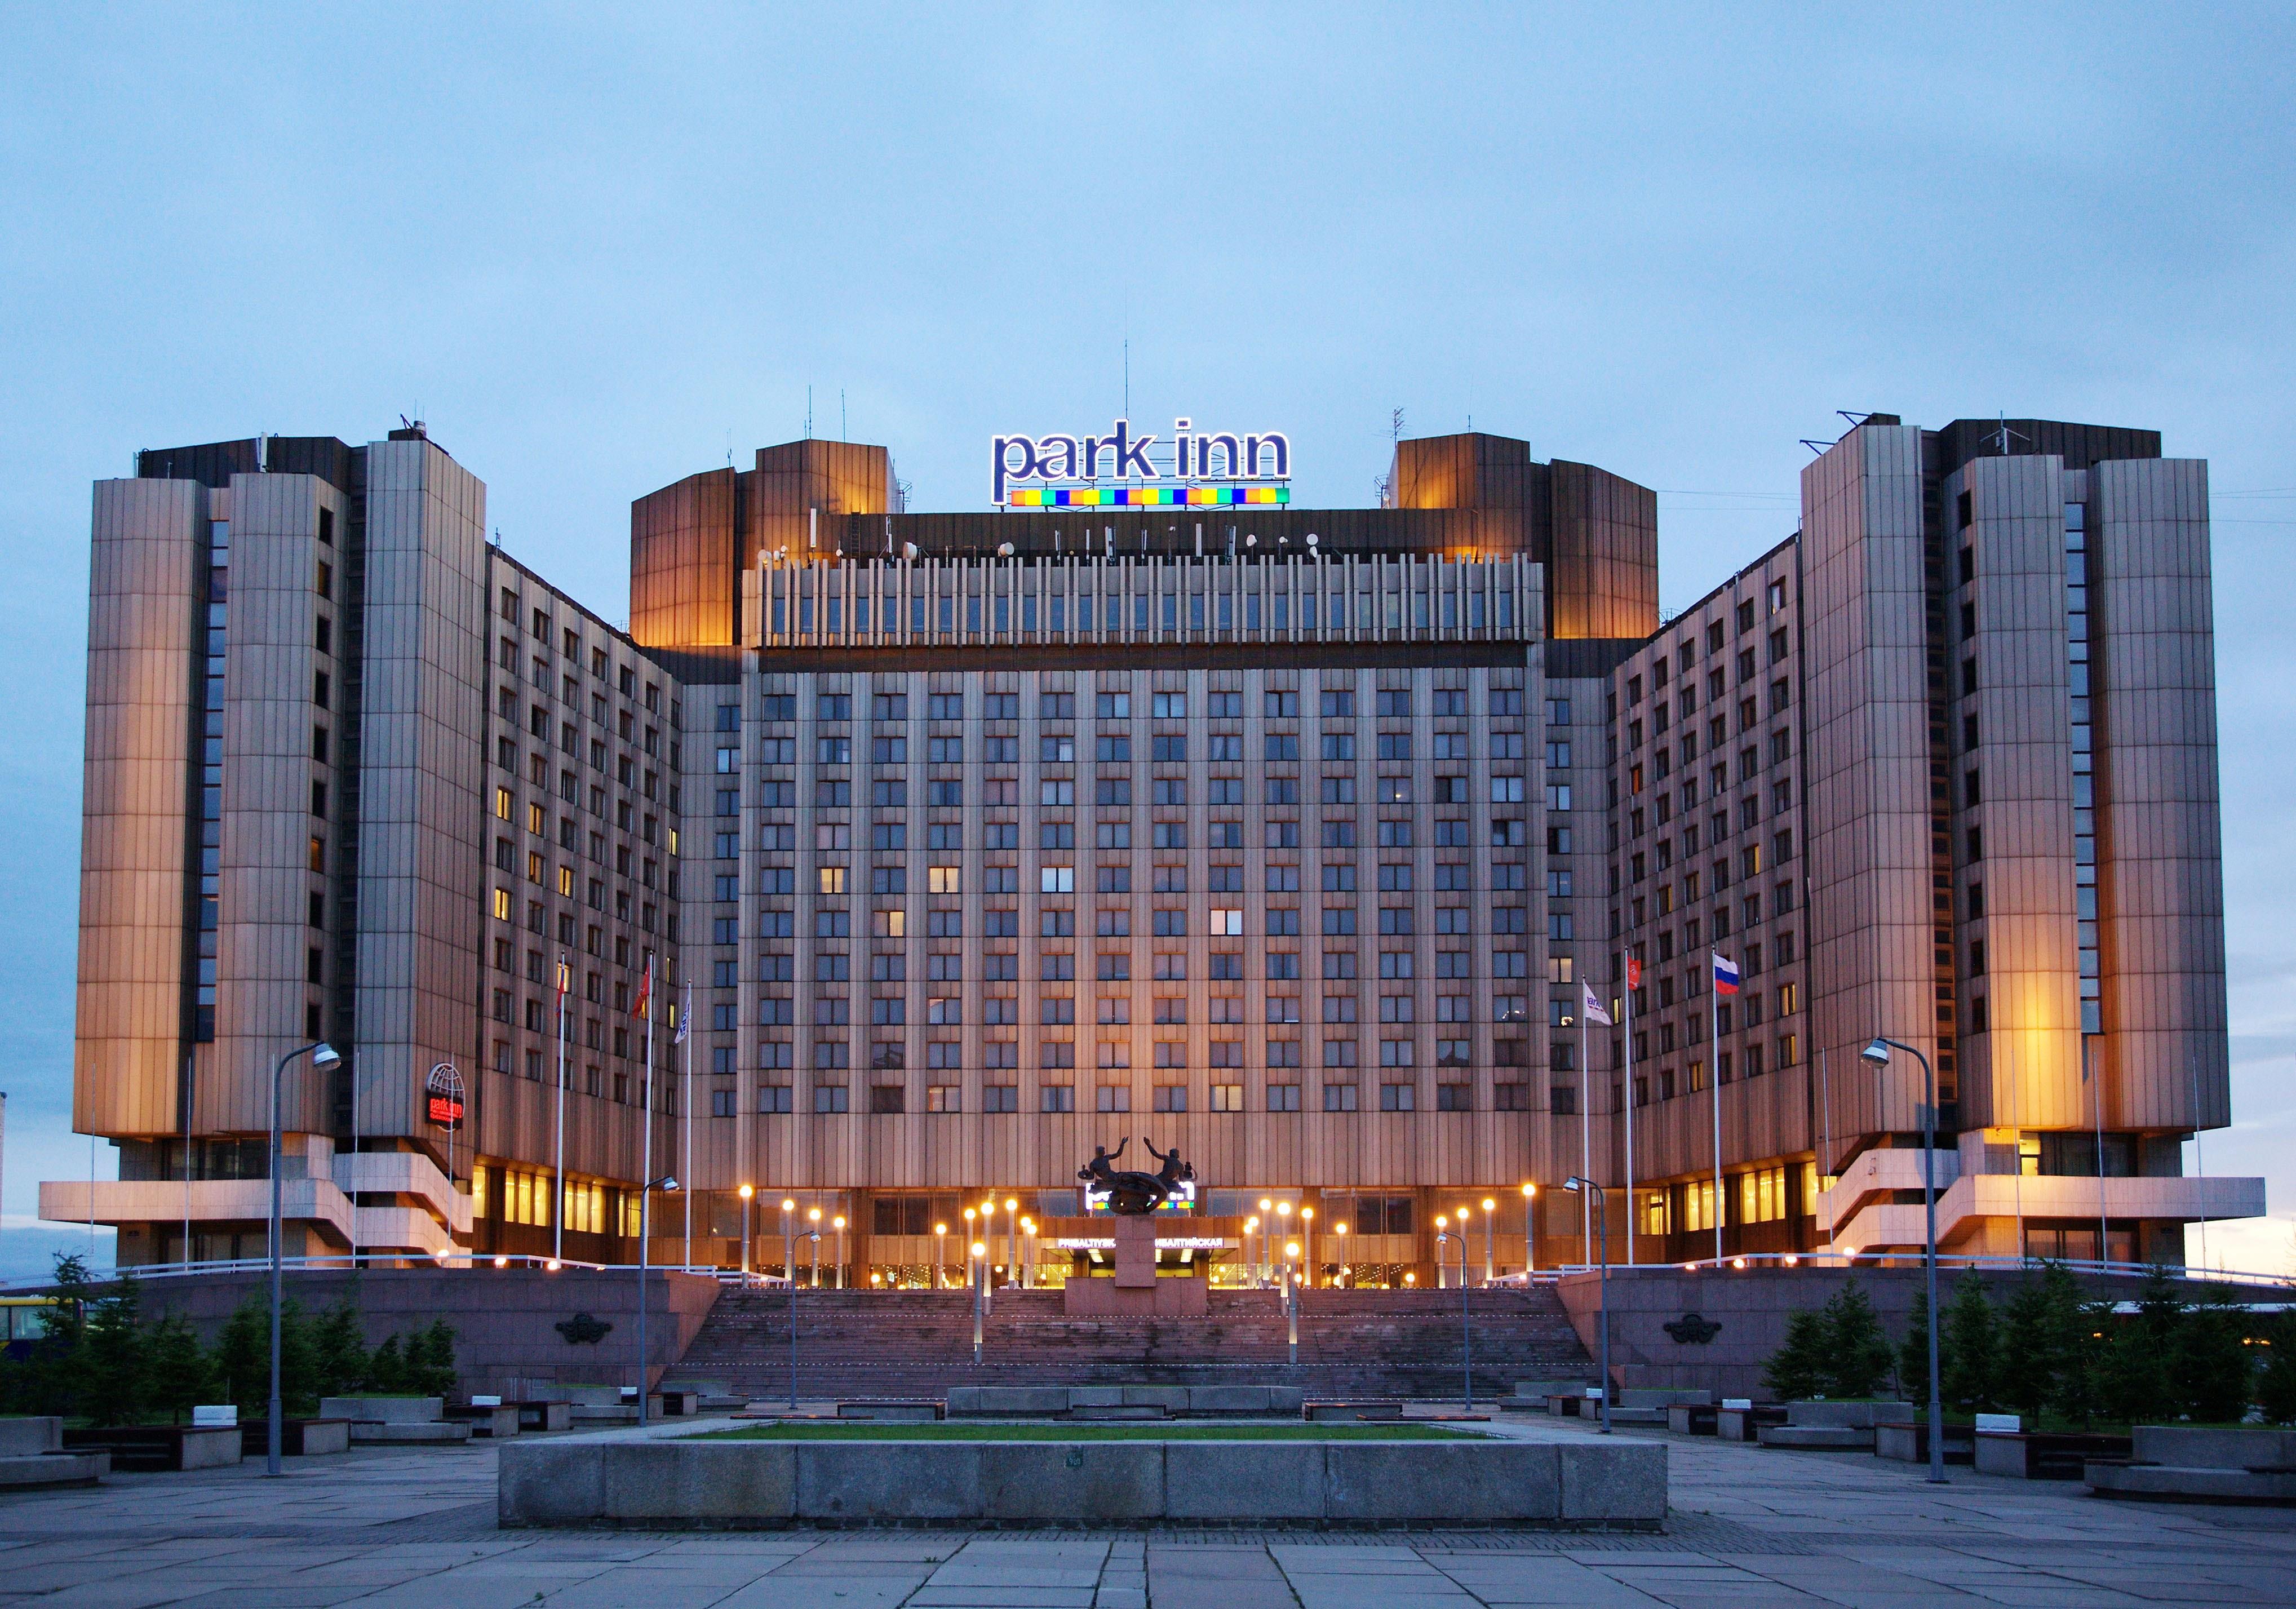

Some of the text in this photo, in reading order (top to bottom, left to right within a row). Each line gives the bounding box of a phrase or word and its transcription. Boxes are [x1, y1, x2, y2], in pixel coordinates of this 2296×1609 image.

[991, 417, 1290, 506] park inn
[430, 1098, 462, 1114] park inn
